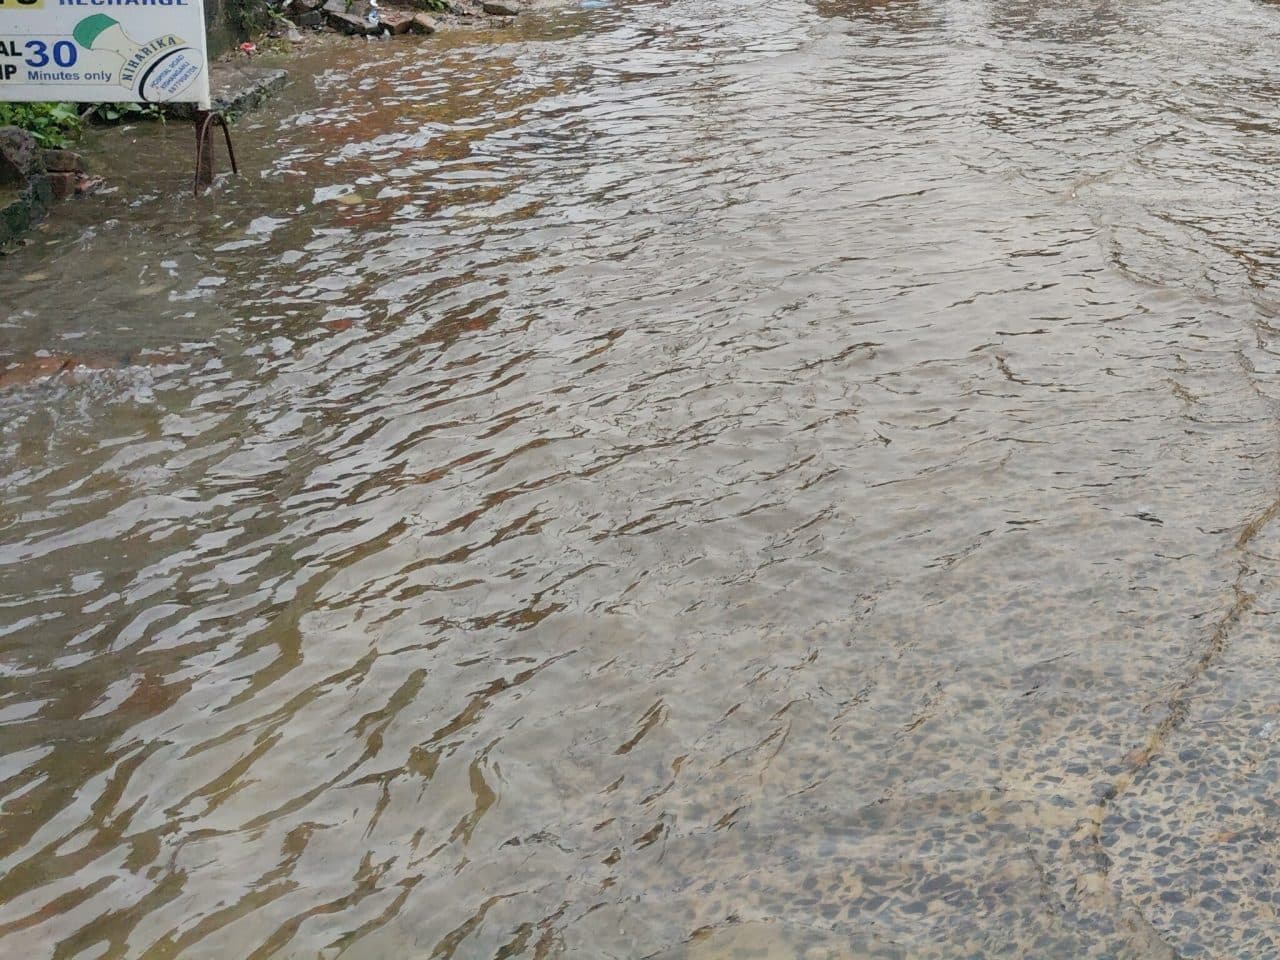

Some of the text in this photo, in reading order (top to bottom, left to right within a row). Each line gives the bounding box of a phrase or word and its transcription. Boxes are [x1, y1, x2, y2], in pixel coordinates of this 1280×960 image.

[24, 40, 78, 68] 30
[121, 35, 177, 82] NIHARIKA
[0, 64, 18, 80] P
[27, 70, 112, 83] Minutes only
